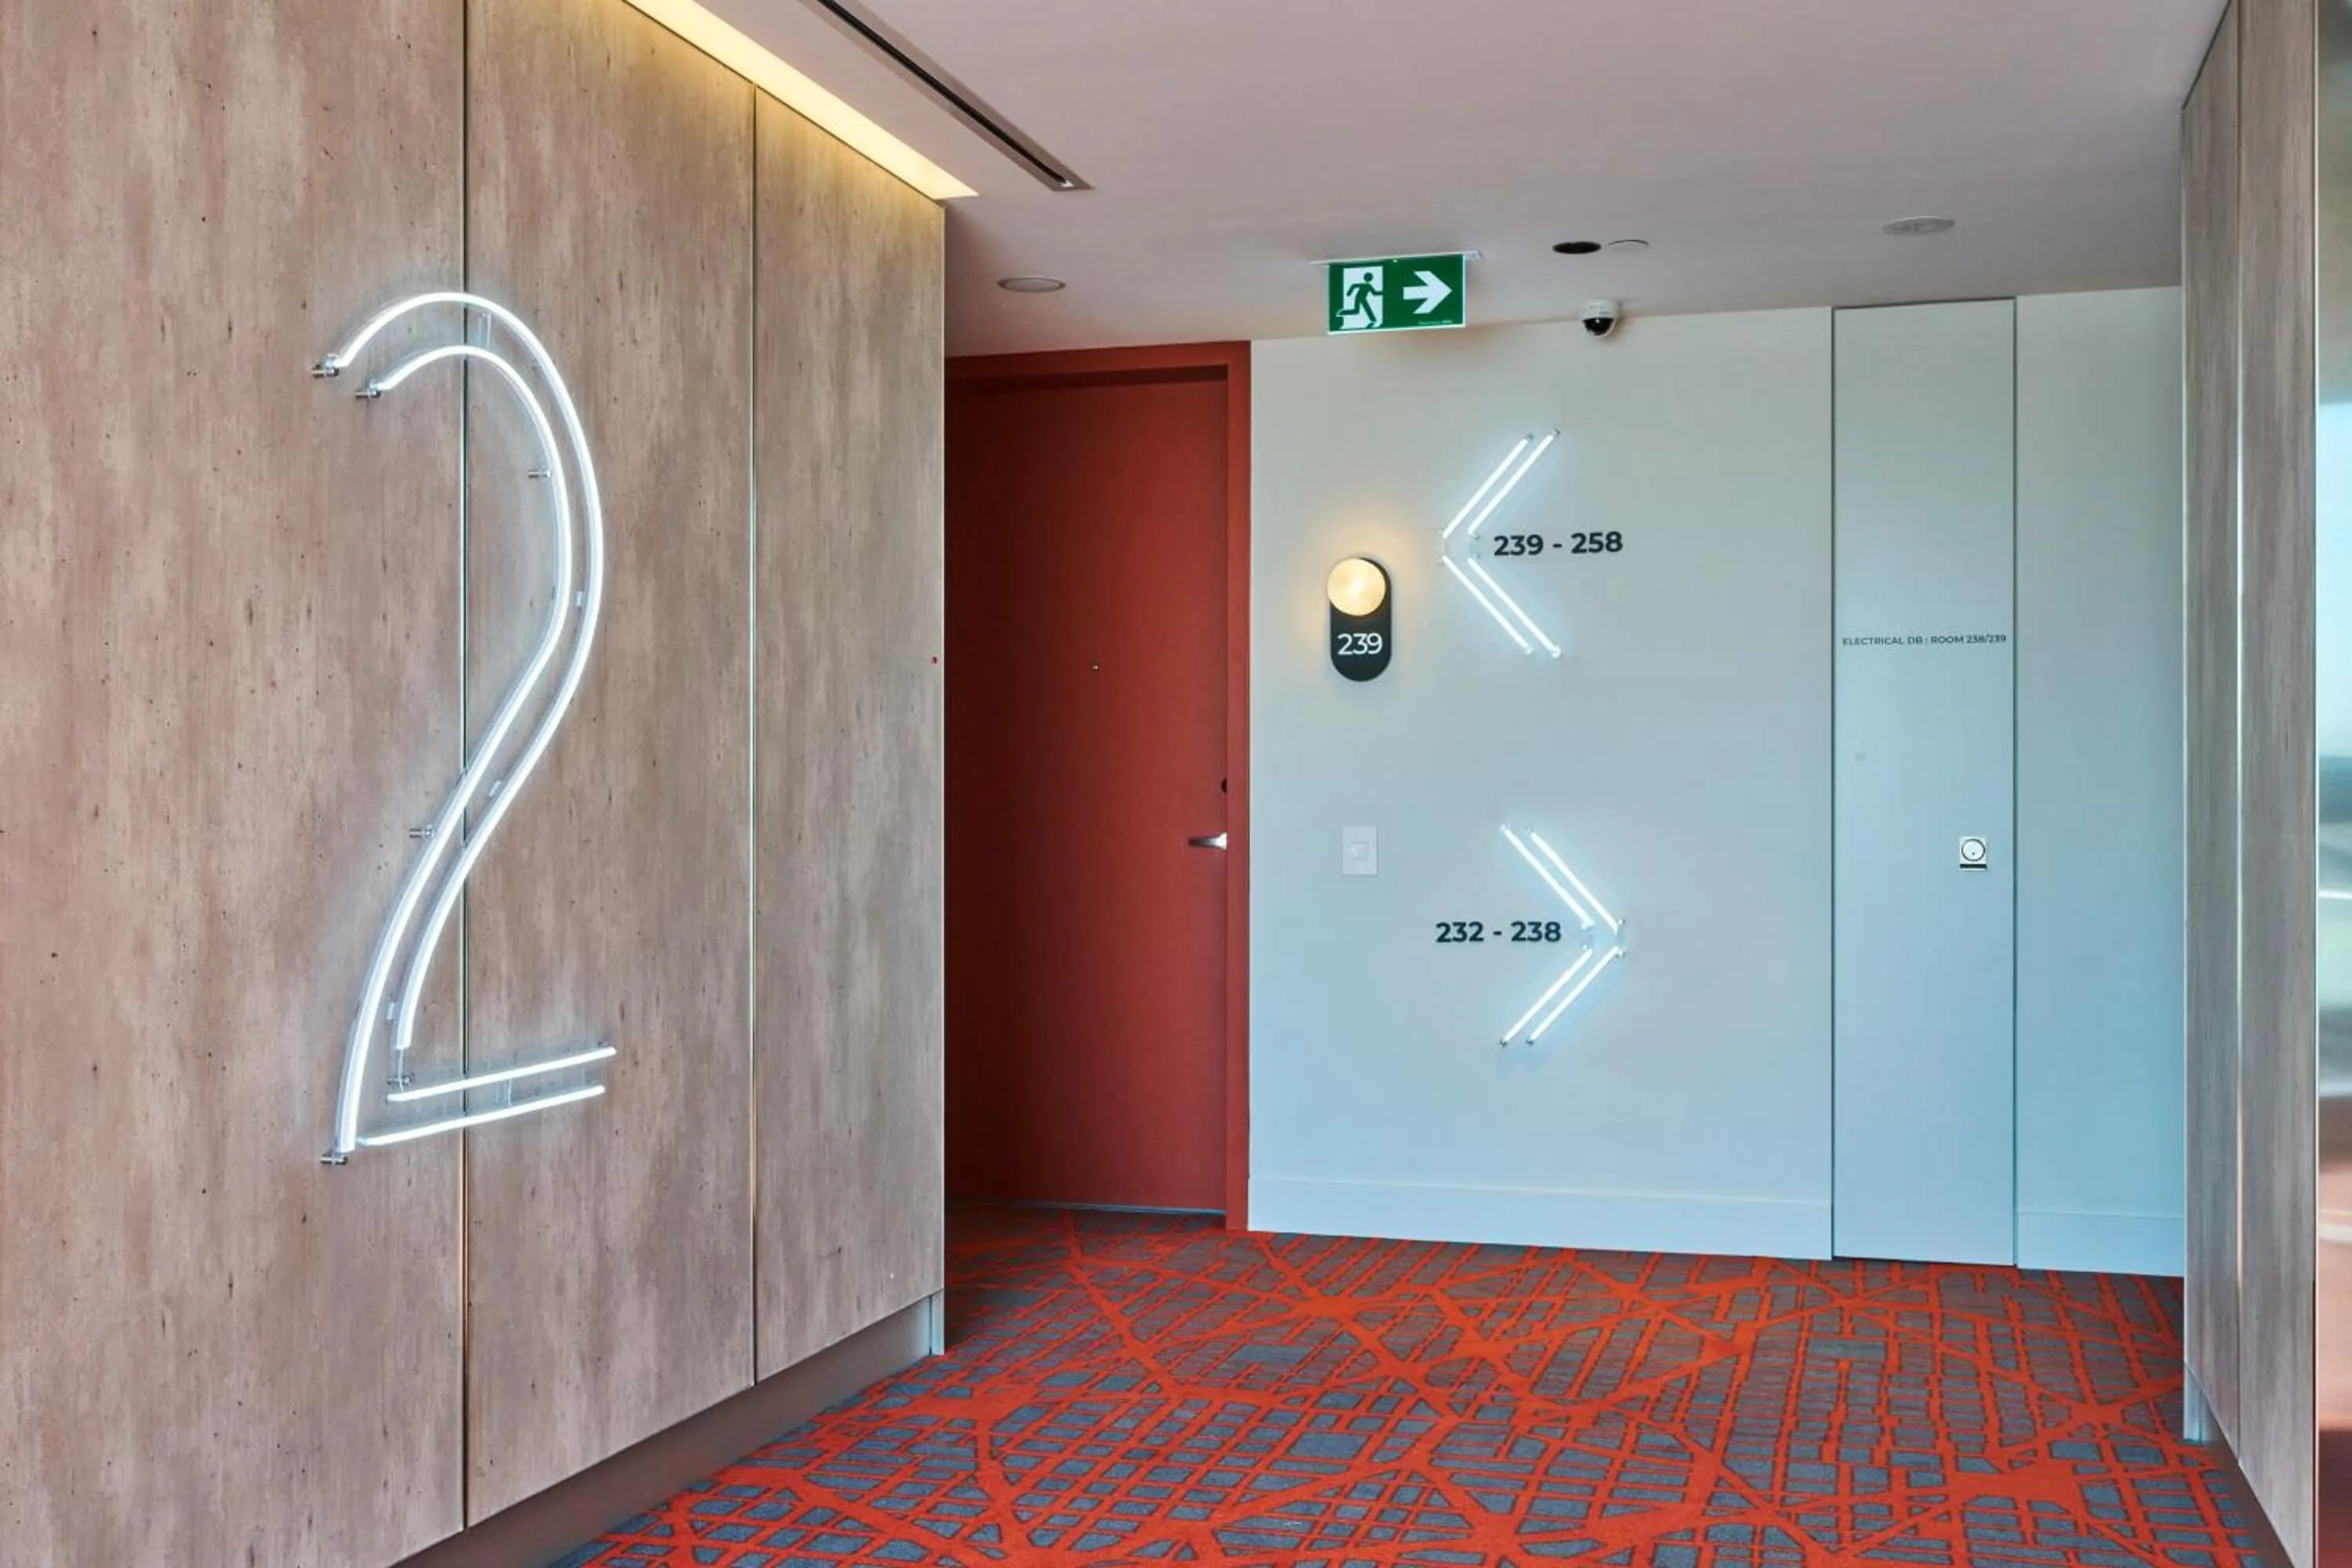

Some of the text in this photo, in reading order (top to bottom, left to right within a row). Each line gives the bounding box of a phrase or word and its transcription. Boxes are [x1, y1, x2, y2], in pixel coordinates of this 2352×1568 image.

[1494, 534, 1544, 556] 239
[1570, 531, 1623, 554] 258
[1338, 633, 1383, 655] 239
[1842, 636, 1904, 646] ELECTRICAL
[1907, 635, 1923, 645] DB
[1930, 634, 1964, 644] ROOM
[1966, 633, 2006, 644] 238/239
[332, 290, 616, 1153] 2
[1436, 921, 1484, 943] 232
[1510, 920, 1562, 942] 238
